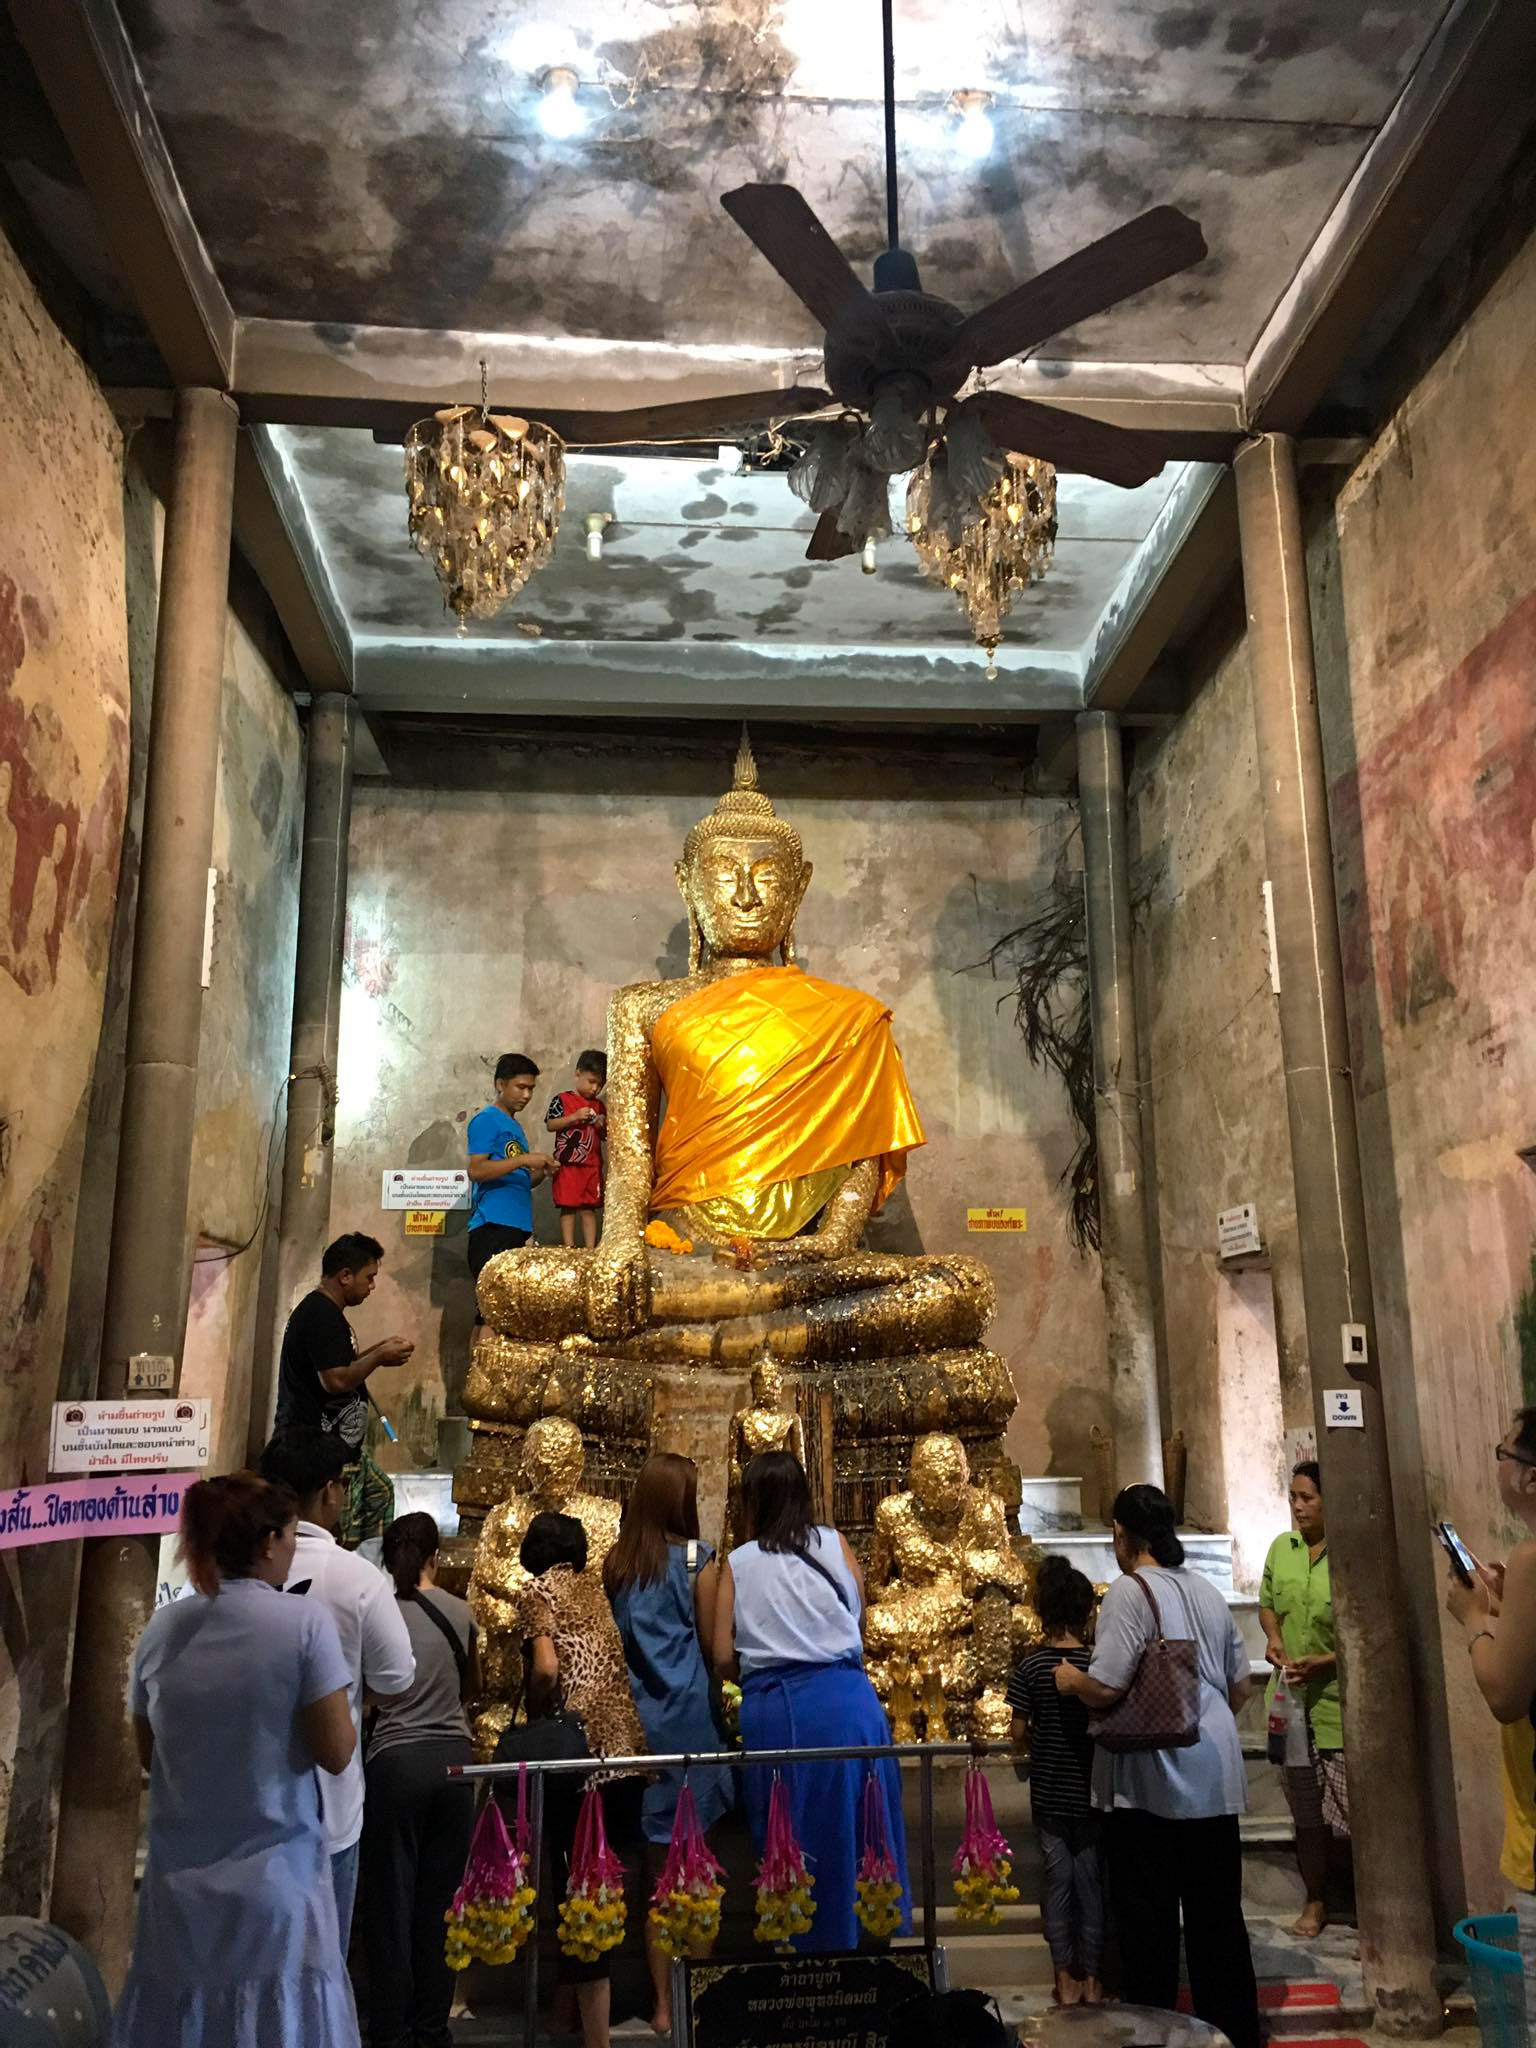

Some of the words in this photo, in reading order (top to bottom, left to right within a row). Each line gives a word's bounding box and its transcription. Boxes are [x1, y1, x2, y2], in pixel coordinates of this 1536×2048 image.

[147, 1373, 168, 1387] UP
[98, 1407, 165, 1426] ห้ามขึ้นถ่ายรูป
[77, 1425, 139, 1437] เป็นนายแบบ
[143, 1424, 182, 1434] นางแบบ
[88, 1455, 117, 1467] ฝ่าฝืน
[121, 1452, 169, 1465] มีโทษปรับ
